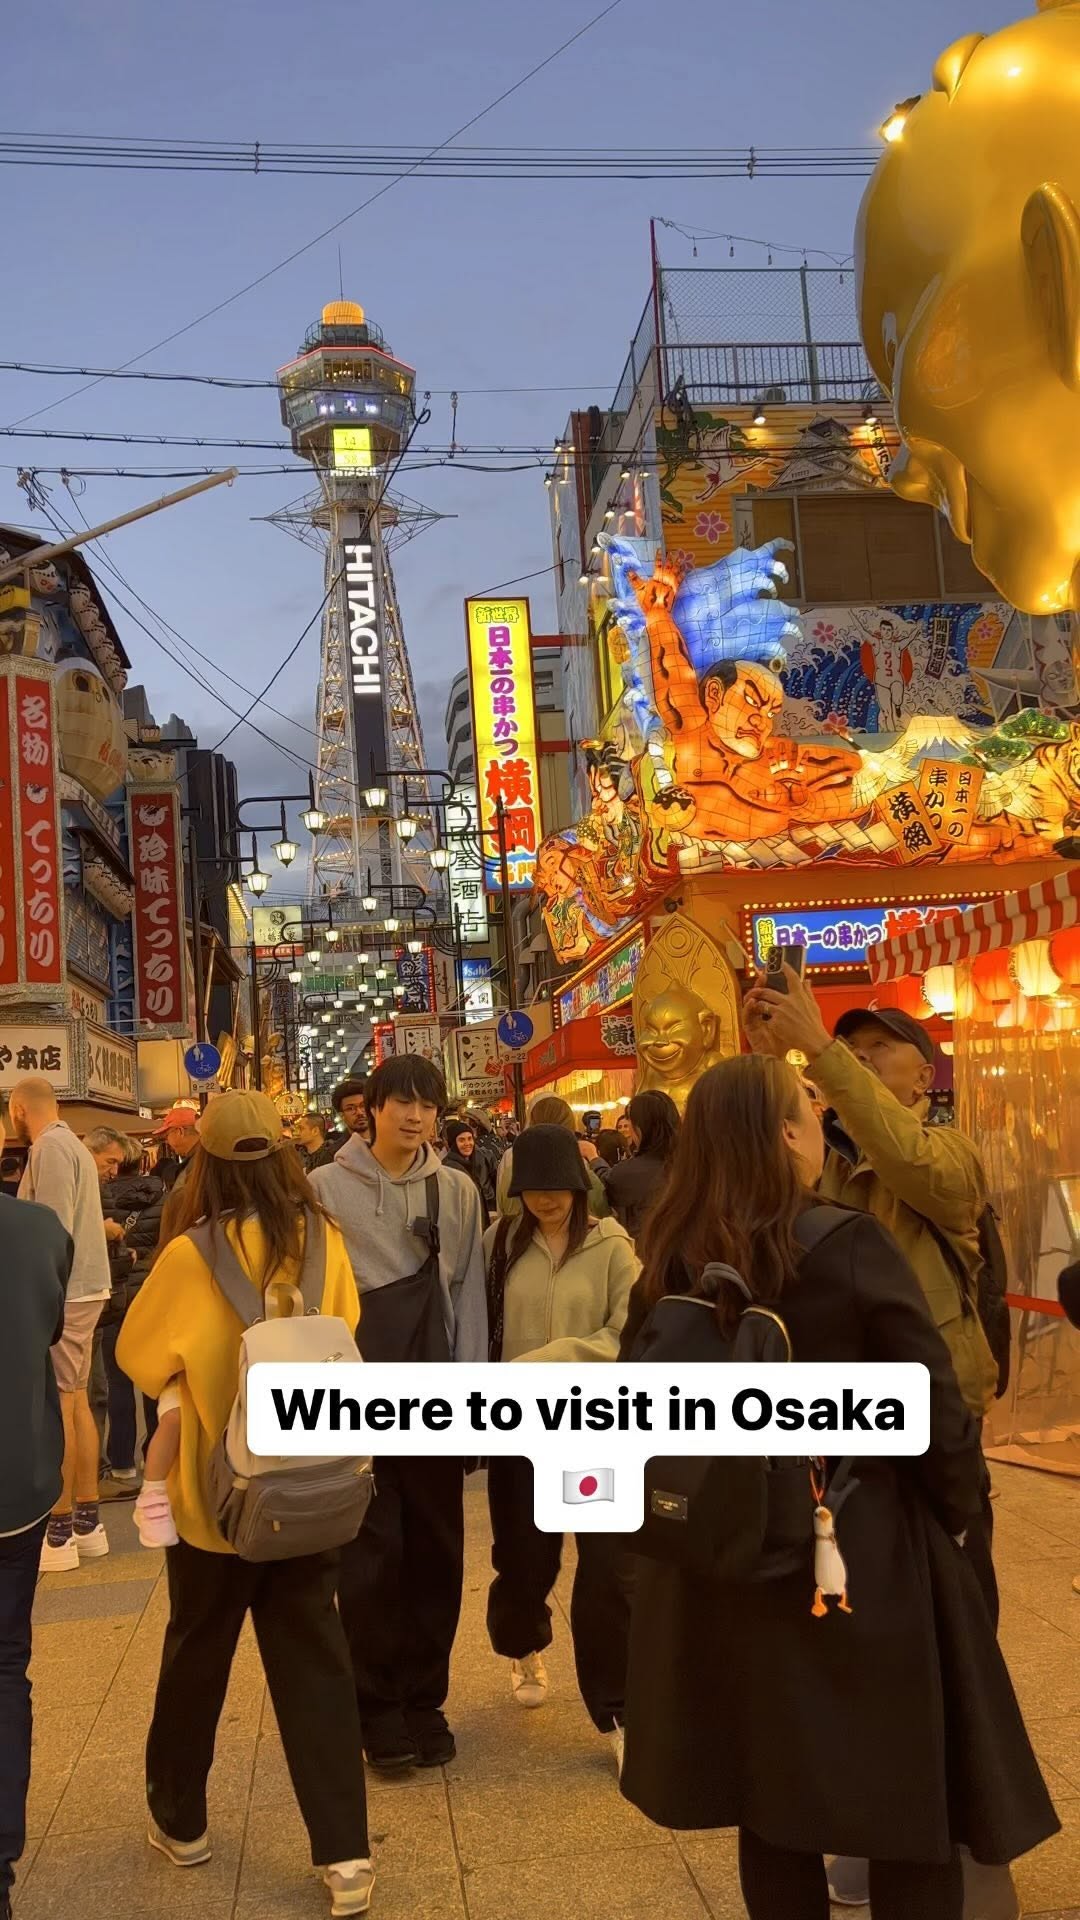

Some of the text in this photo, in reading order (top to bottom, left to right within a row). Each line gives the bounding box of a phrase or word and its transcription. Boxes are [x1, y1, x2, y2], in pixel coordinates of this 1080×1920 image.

[344, 544, 381, 694] HITACHI
[475, 606, 519, 624] 新世界
[484, 626, 537, 856] 日本一の串かつ 横綱
[924, 767, 948, 830] 串かつ
[947, 771, 972, 838] 日本一の
[24, 819, 55, 968] てっちり
[776, 922, 882, 949] 日本一の串かつ
